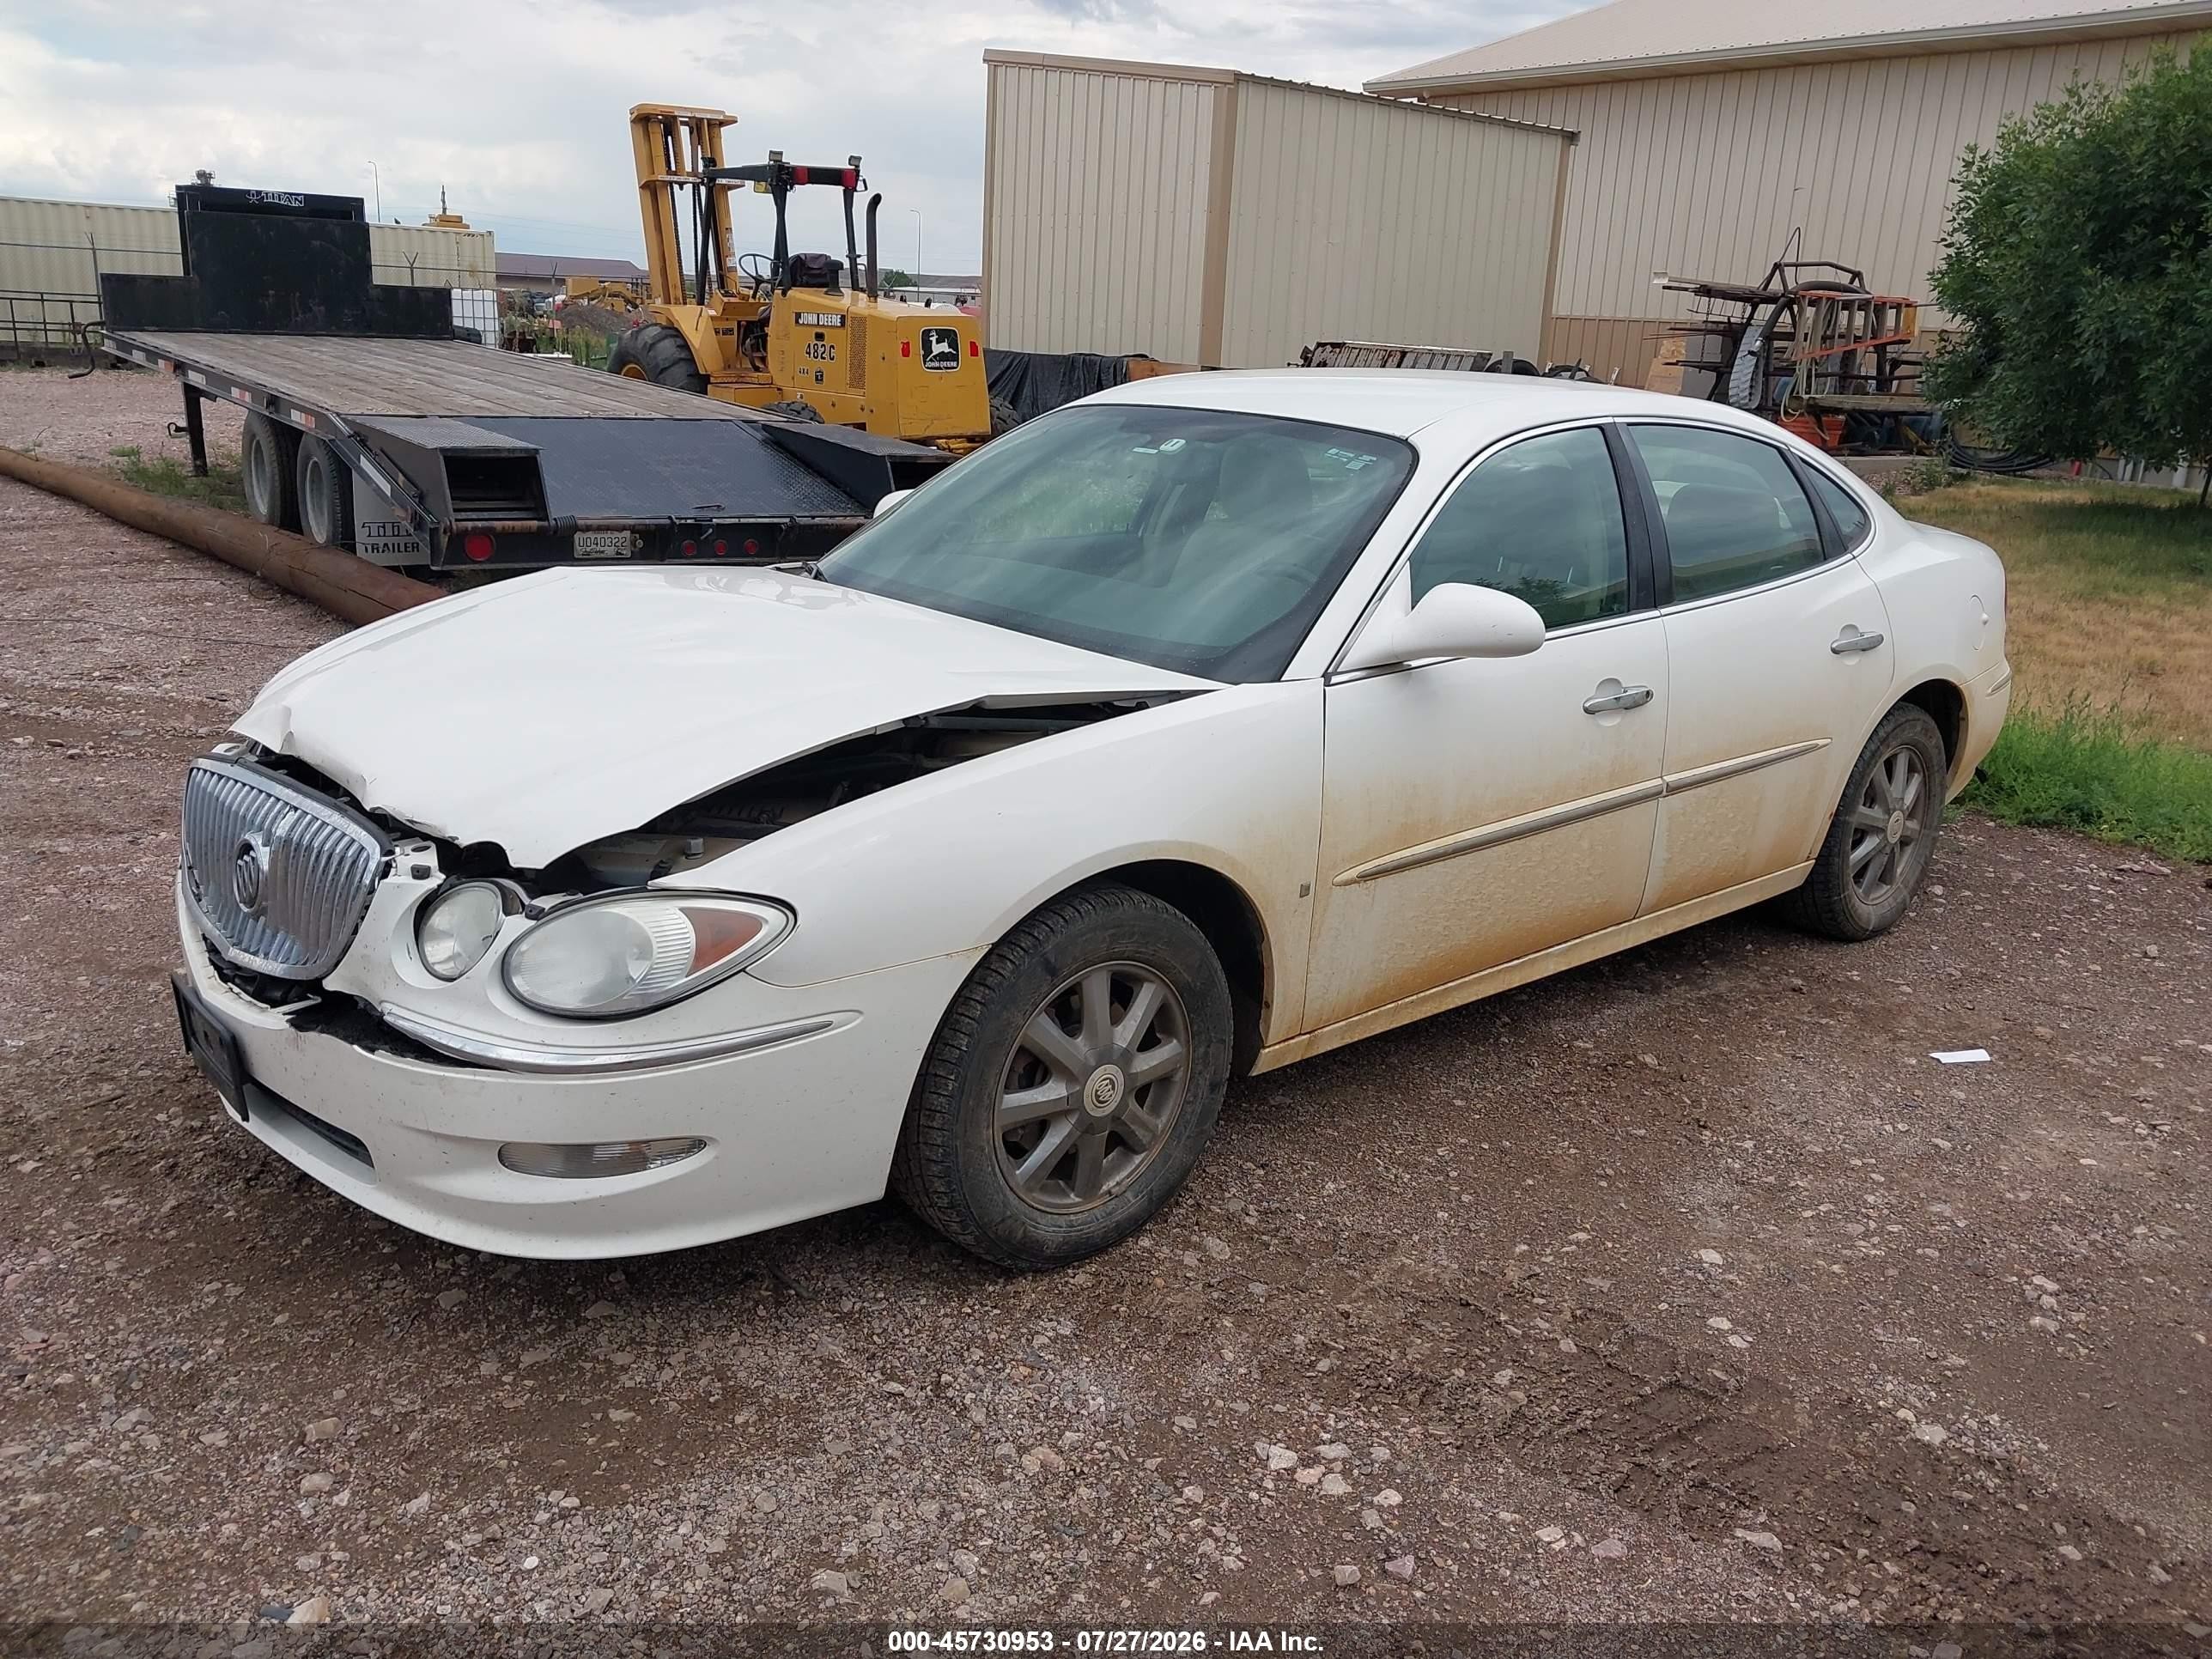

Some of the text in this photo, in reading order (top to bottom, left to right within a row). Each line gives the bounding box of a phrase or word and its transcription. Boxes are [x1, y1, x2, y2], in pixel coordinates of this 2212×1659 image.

[262, 191, 304, 206] TITAN
[799, 313, 842, 326] JOHN DEERE
[805, 342, 836, 362] 482C
[363, 542, 420, 554] TRAILER
[578, 536, 628, 548] U040322
